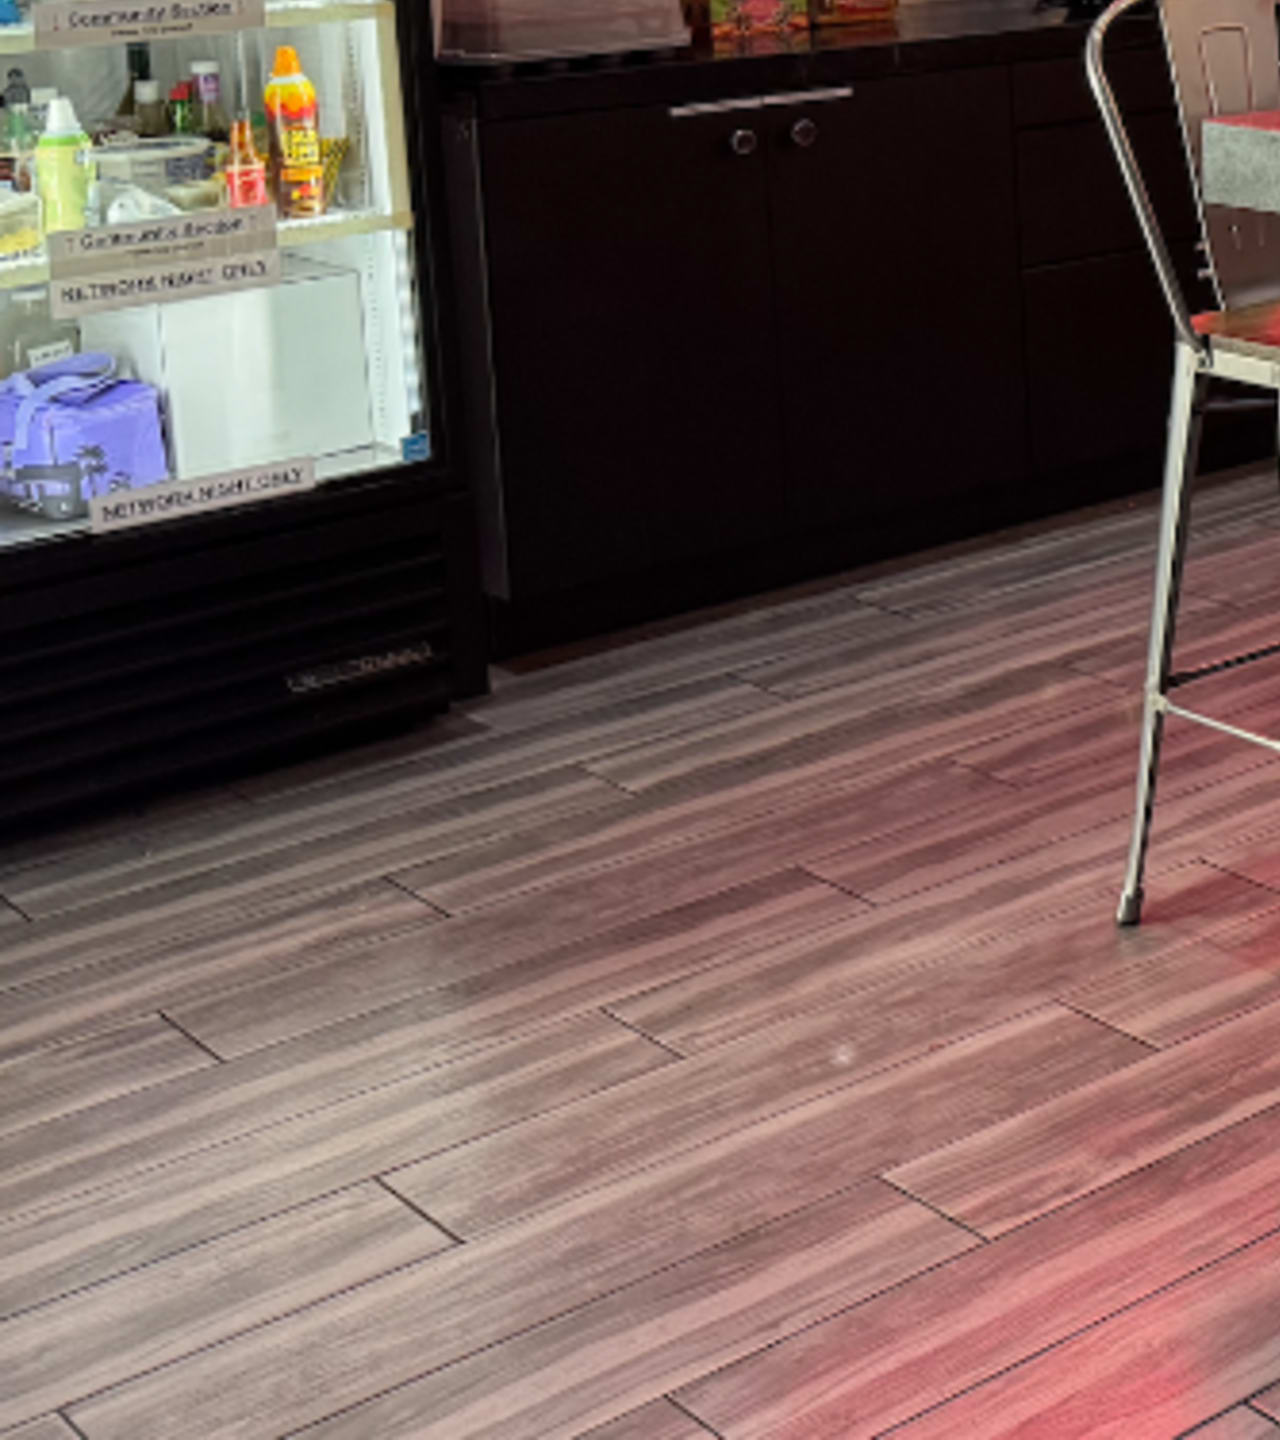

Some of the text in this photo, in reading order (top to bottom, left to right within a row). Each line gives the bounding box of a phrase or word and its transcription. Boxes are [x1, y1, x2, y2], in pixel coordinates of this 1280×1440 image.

[102, 468, 303, 522] NETWORK NIGHT ONLY
